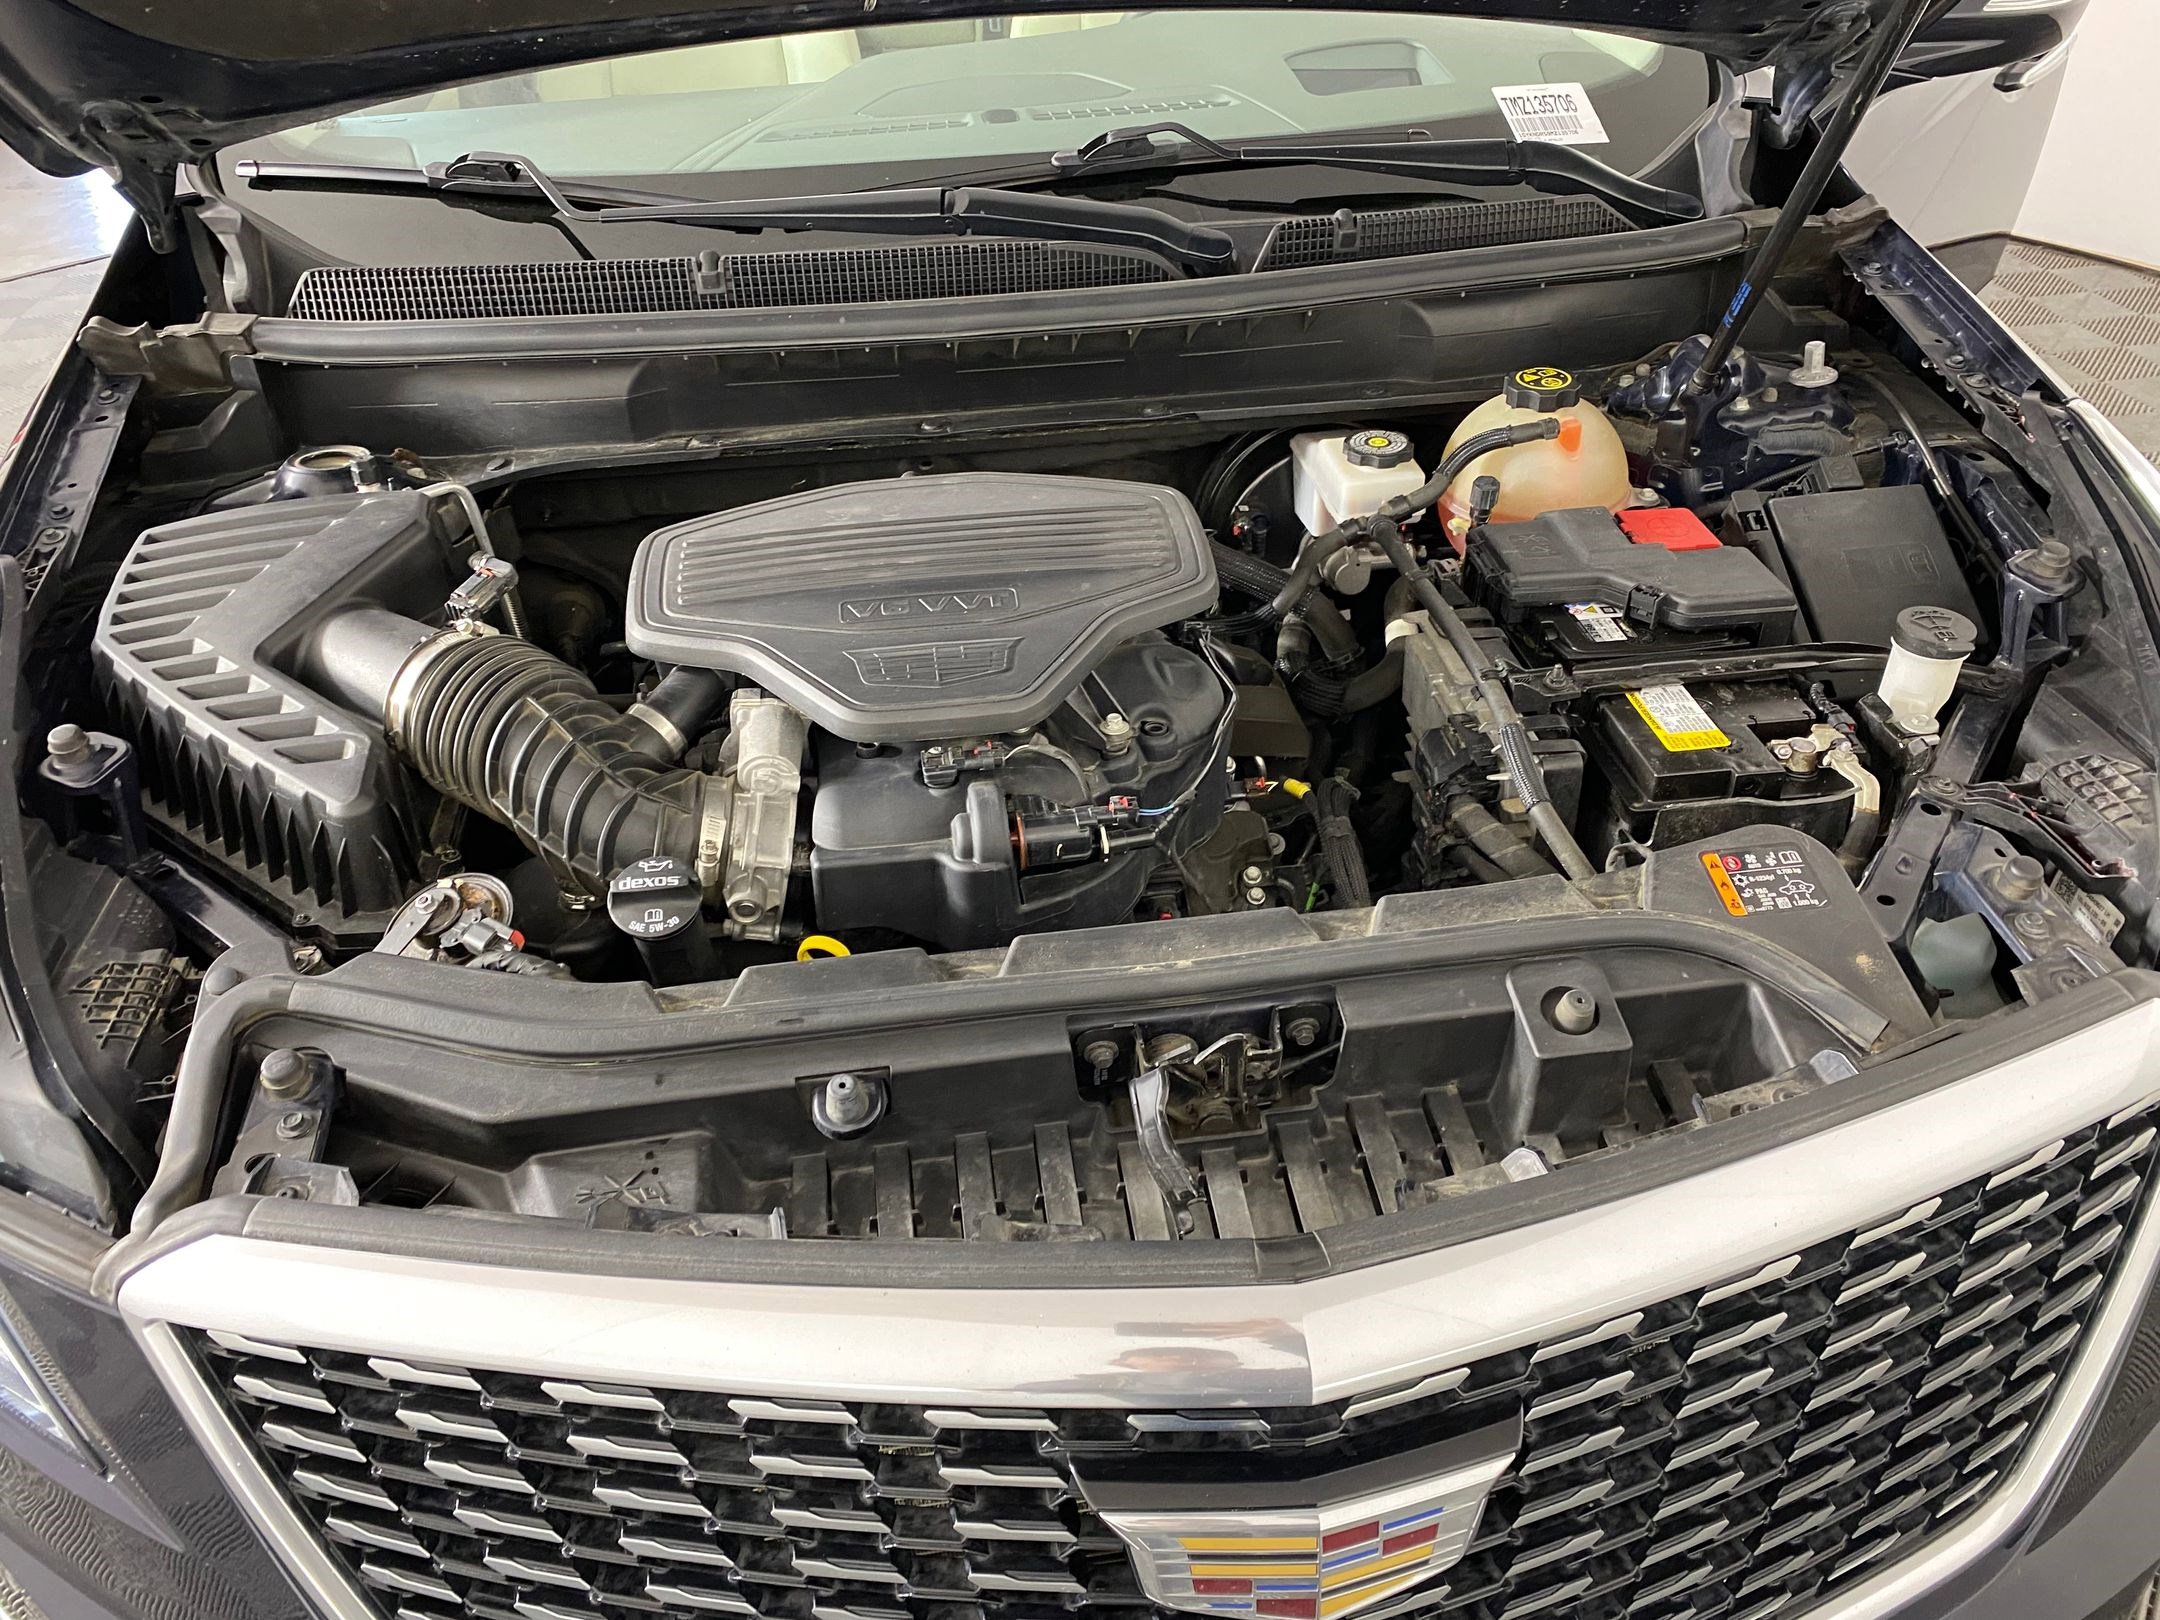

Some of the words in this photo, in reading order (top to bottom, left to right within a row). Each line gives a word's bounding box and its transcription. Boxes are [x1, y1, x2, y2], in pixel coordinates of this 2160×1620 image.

[1500, 94, 1578, 117] TMZ135706
[847, 600, 911, 618] V6
[918, 592, 1010, 612] VVT
[618, 875, 682, 890] dexos
[628, 920, 647, 933] SAE
[648, 915, 680, 933] 5W-30
